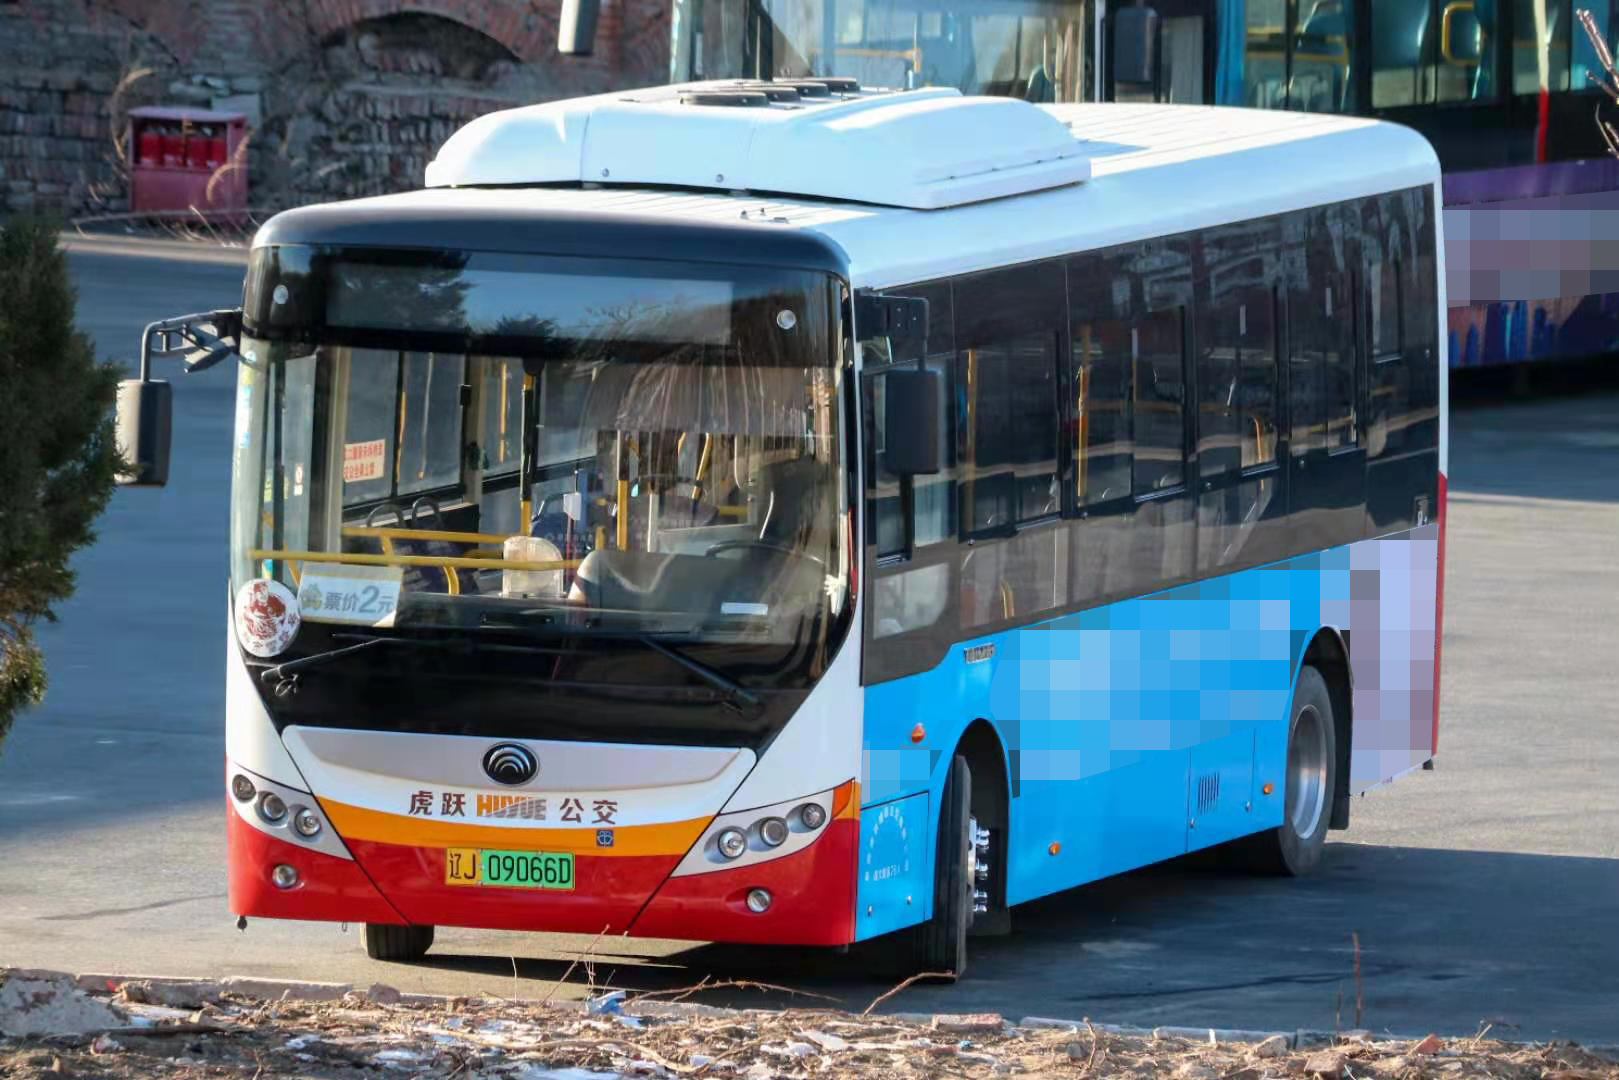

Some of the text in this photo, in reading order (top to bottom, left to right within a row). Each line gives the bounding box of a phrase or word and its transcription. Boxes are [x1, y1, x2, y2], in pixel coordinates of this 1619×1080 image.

[323, 584, 395, 614] 票价2元
[408, 790, 618, 825] 虎跃 HUYUE 公交
[488, 855, 571, 884] 09066D
